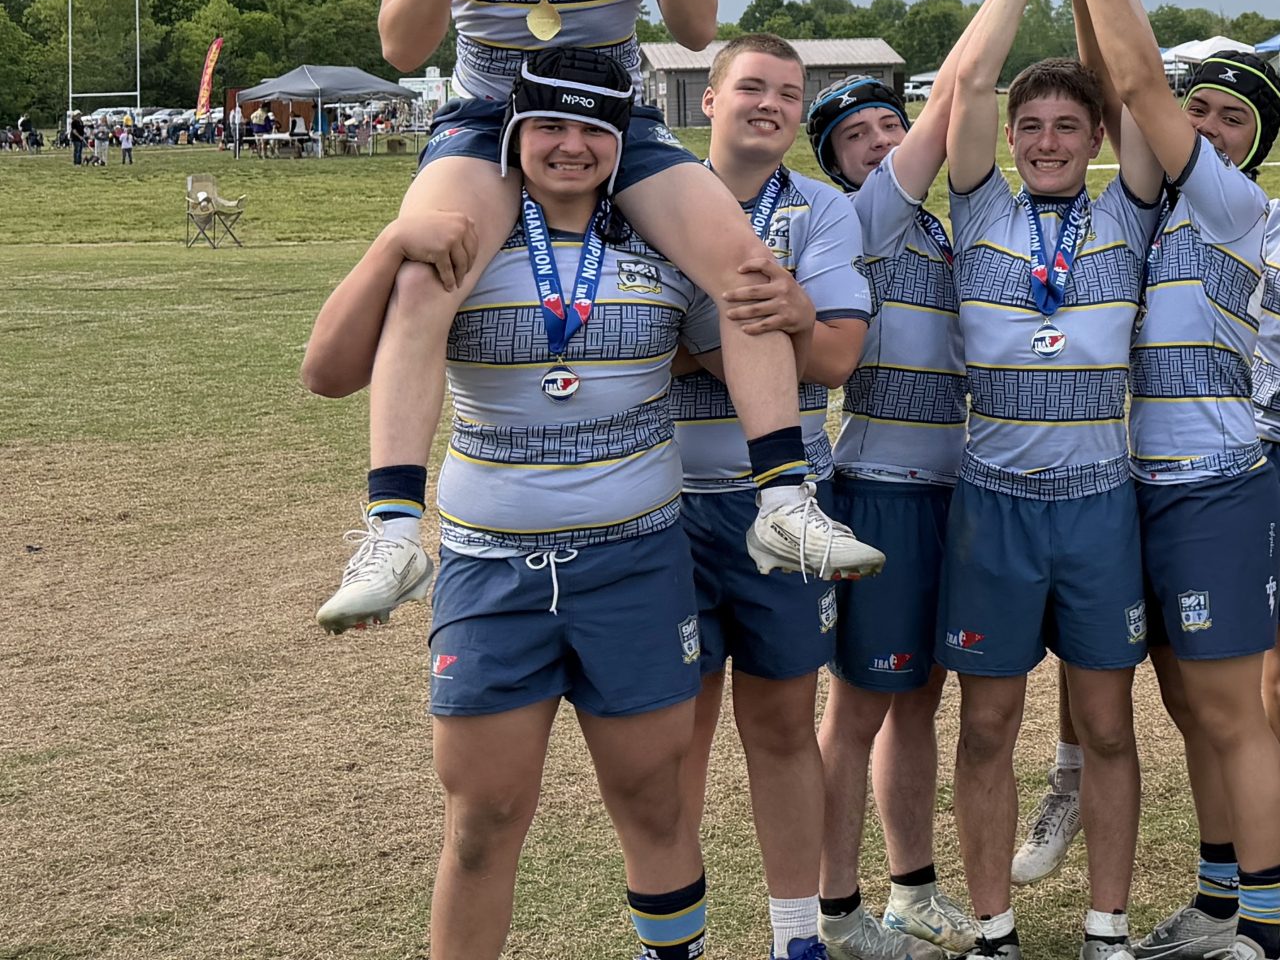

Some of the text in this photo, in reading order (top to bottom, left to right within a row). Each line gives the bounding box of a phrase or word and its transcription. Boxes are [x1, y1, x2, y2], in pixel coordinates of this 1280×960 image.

[523, 200, 553, 275] CHAMPION
[1060, 226, 1078, 254] 2026
[538, 280, 552, 297] TRA
